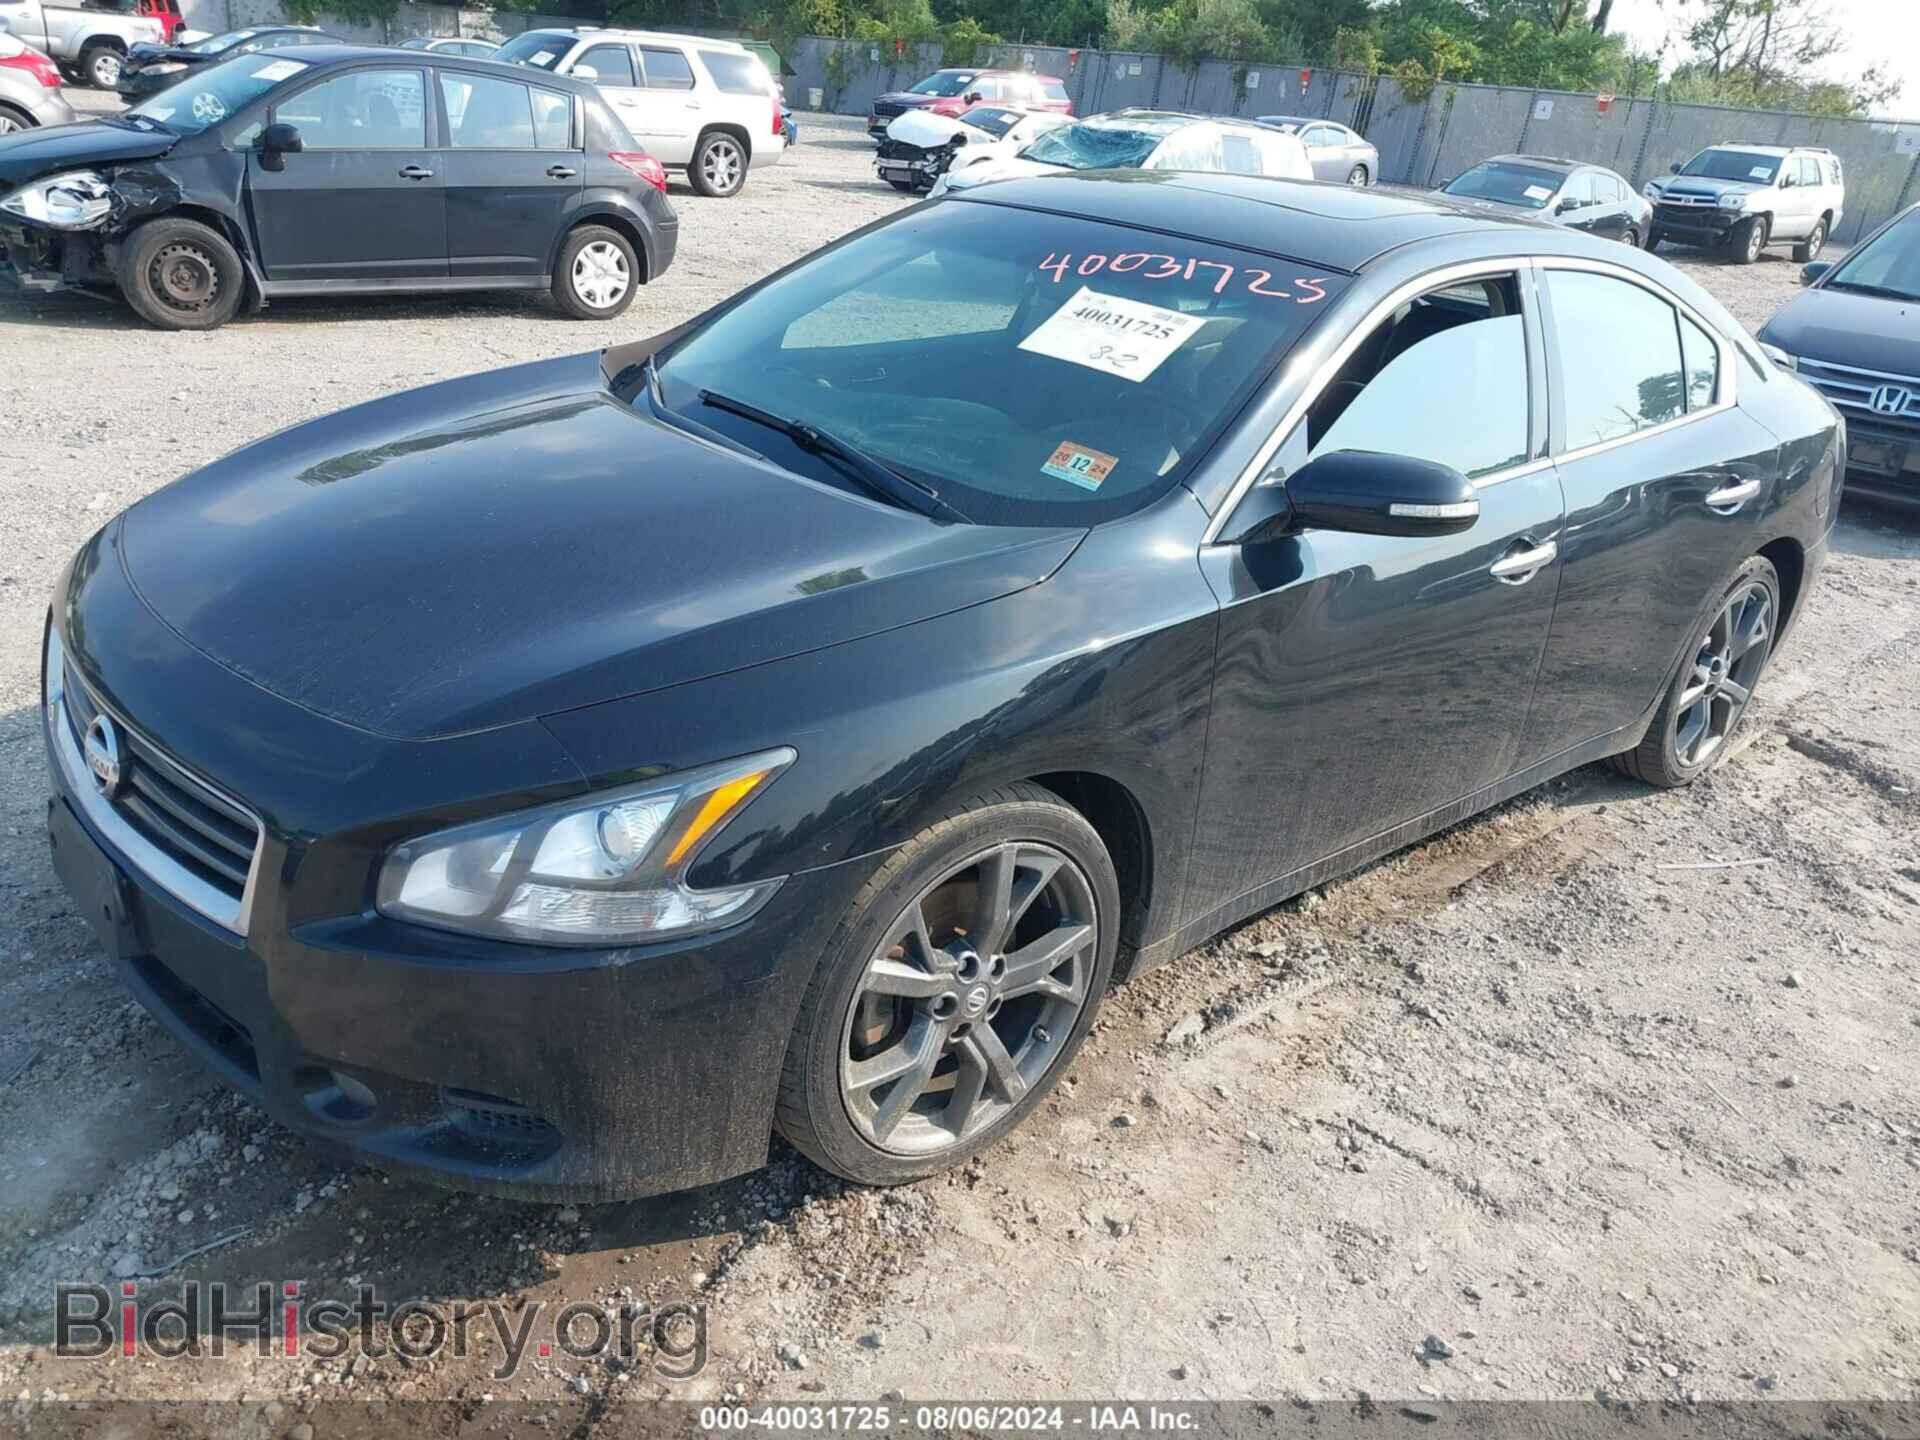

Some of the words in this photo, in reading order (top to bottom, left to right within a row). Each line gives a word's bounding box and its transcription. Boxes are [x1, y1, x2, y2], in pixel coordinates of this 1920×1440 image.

[1039, 253, 1330, 304] 40031725
[1073, 306, 1174, 340] 40031725
[1071, 457, 1091, 472] 12
